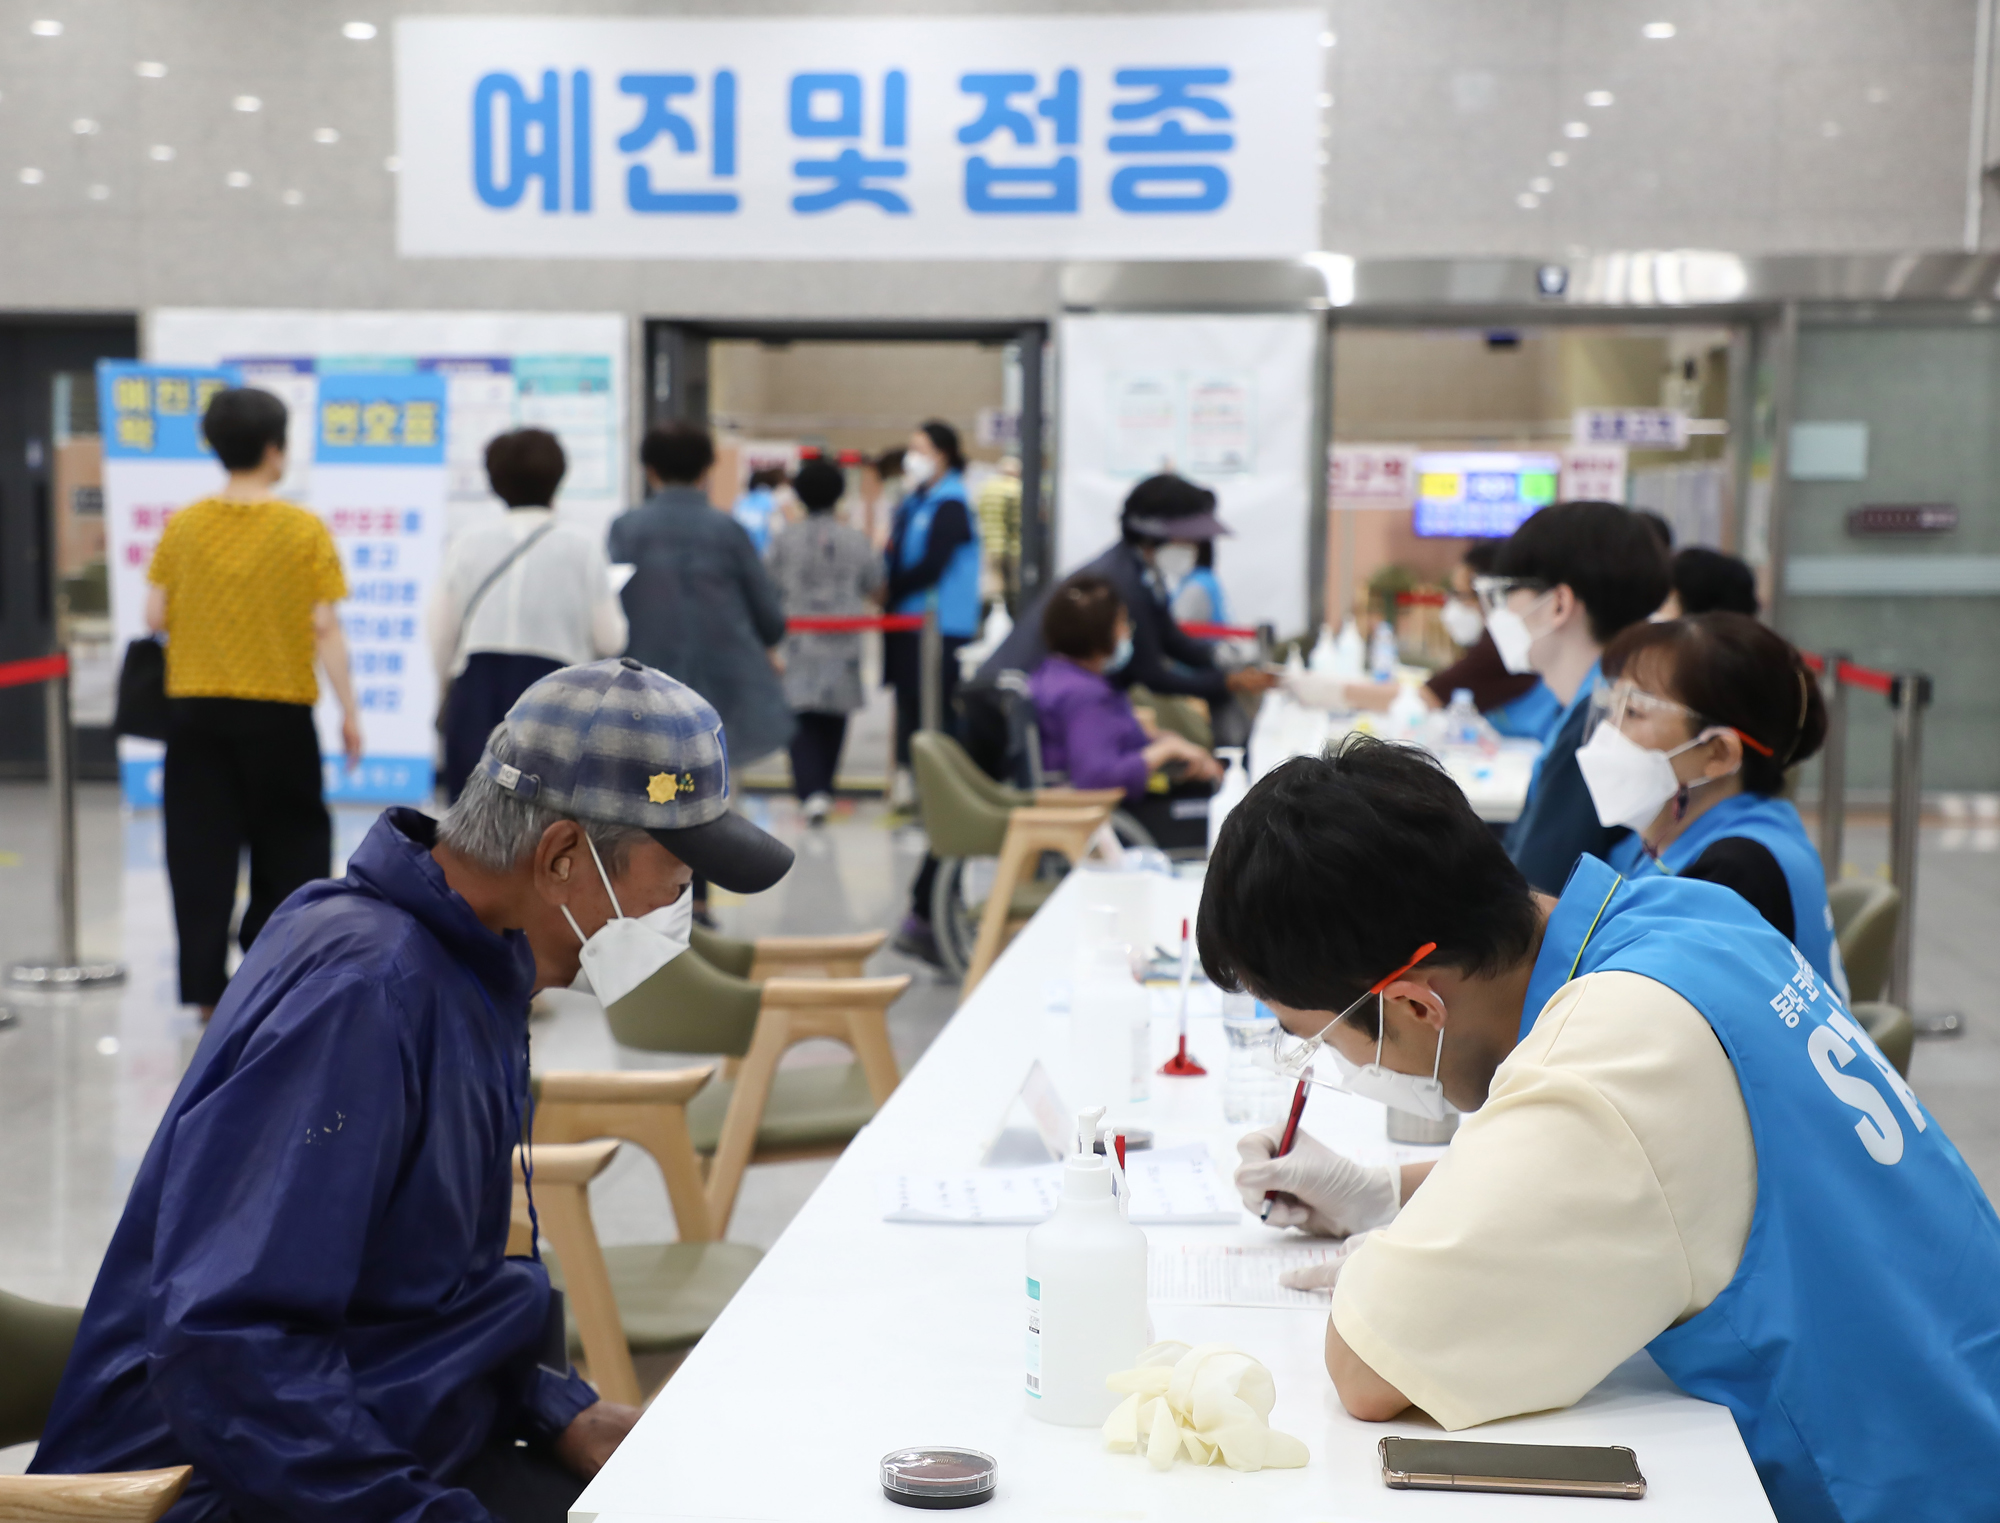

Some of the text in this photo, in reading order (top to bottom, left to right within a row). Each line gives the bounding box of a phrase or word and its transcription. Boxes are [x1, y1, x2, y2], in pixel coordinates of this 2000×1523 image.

[473, 68, 1236, 215] 예진 및 접종
[322, 401, 438, 446] 번호표
